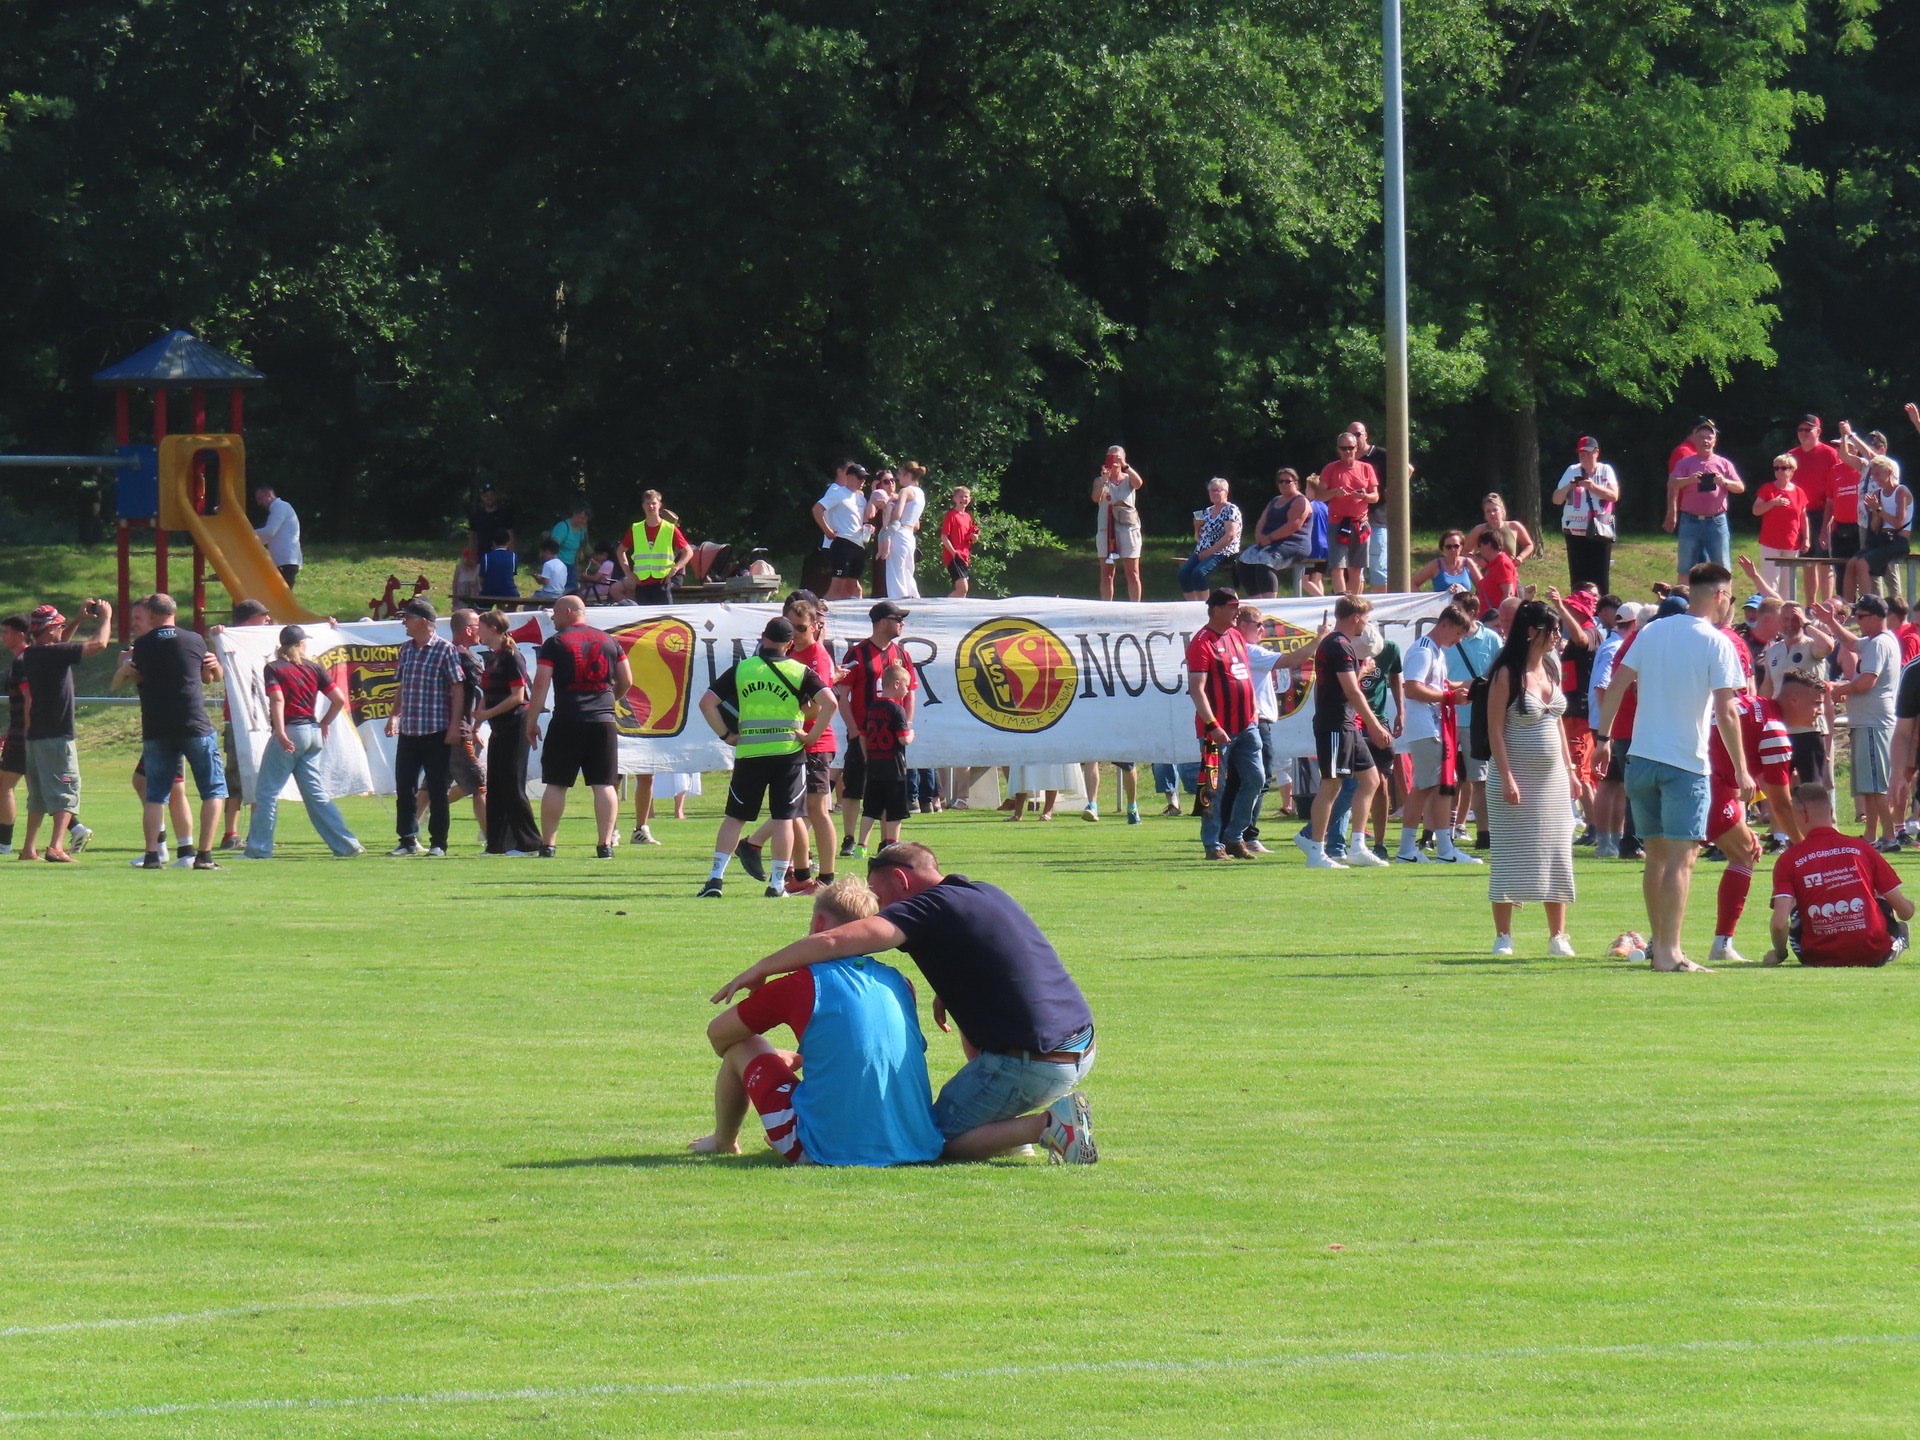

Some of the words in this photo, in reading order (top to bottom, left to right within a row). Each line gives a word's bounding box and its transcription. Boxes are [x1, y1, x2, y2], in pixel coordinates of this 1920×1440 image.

[320, 647, 350, 670] BSG
[351, 645, 402, 662] LOKOM
[565, 641, 609, 682] 16
[742, 681, 789, 701] ORDNER
[361, 702, 396, 720] STEN
[962, 684, 983, 710] LOK
[985, 710, 1045, 728] ALTMARK
[866, 720, 895, 751] 26
[1794, 856, 1808, 868] SSV
[1807, 852, 1817, 860] 80
[1816, 846, 1862, 857] GARDELEGEN
